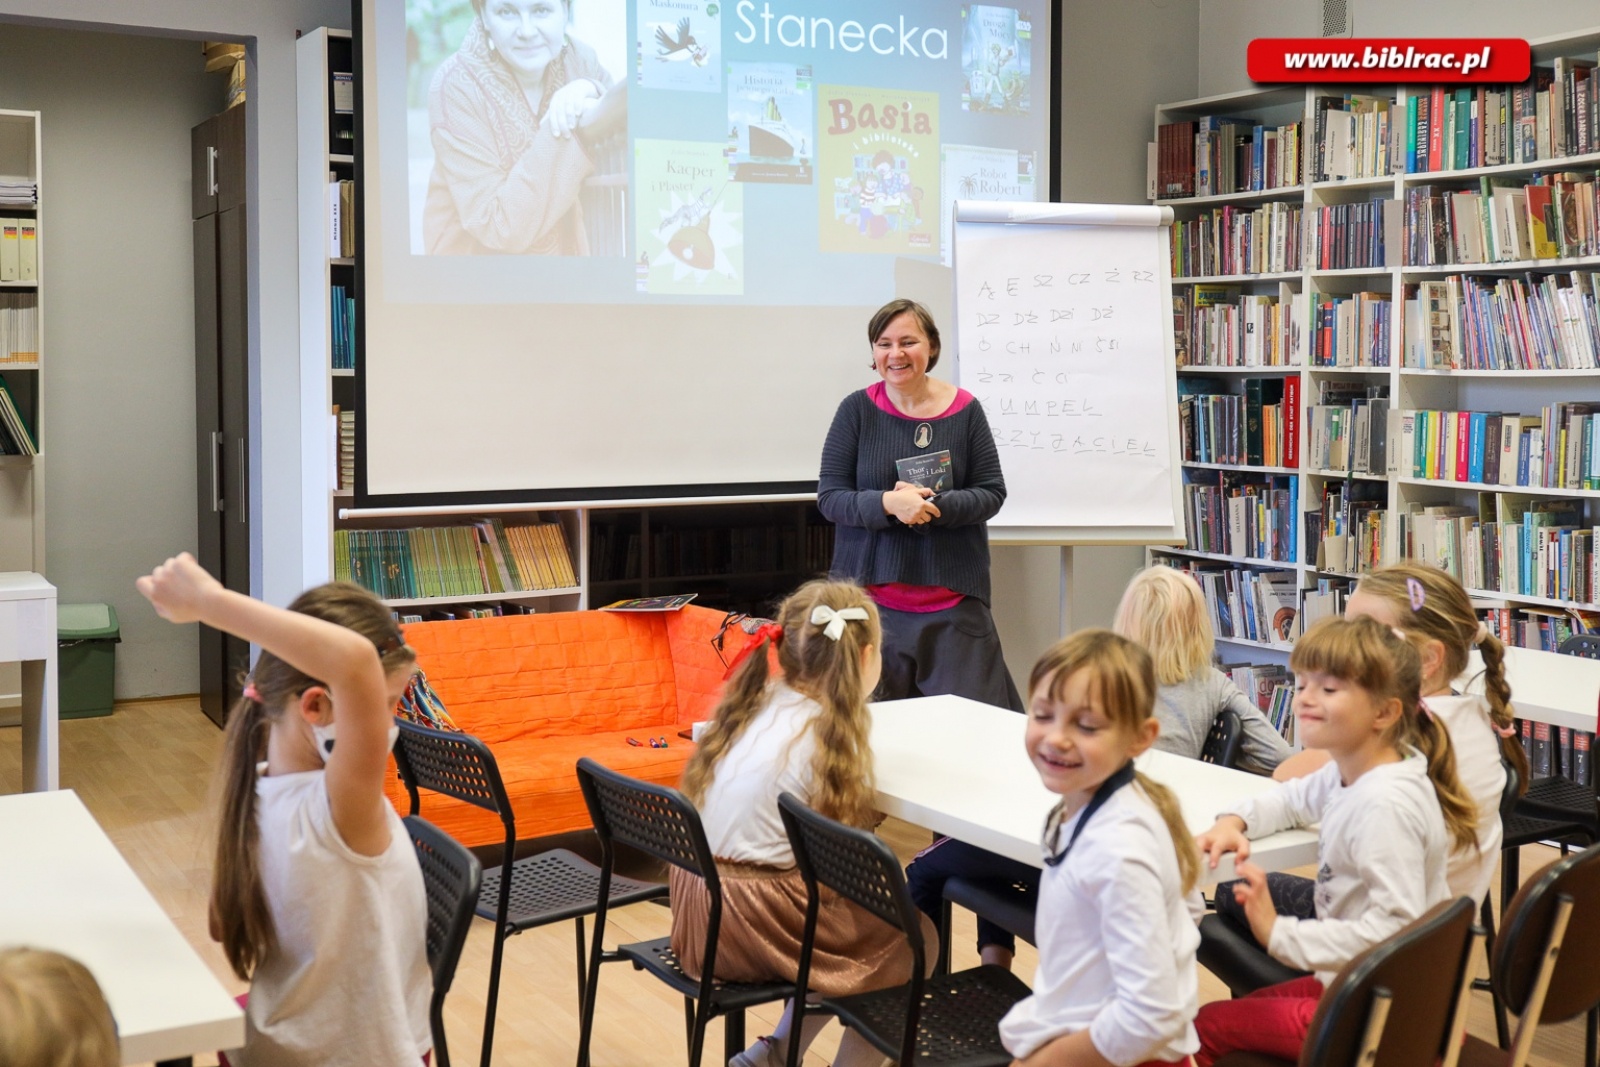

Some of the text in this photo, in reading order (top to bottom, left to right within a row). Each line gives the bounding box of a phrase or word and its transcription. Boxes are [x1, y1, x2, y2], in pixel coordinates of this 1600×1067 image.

[734, 0, 948, 60] Stanecka
[983, 19, 1007, 29] Droga
[744, 74, 783, 86] Historia
[828, 98, 932, 135] Basia
[1433, 127, 1440, 138] XX
[861, 132, 920, 159] biblioteka
[667, 160, 716, 180] Kacper
[980, 167, 1008, 179] Robot
[659, 180, 695, 193] Plaster
[980, 180, 1023, 196] Robert
[978, 267, 1154, 300] Ą Ę SZ CZ Ż RZ
[975, 311, 1001, 328] DZ
[1090, 304, 1114, 322] DŻ
[978, 335, 992, 352] Ó
[1005, 340, 1030, 355] CH
[907, 466, 925, 476] Thor
[930, 466, 947, 475] Loki
[1577, 754, 1583, 764] 7
